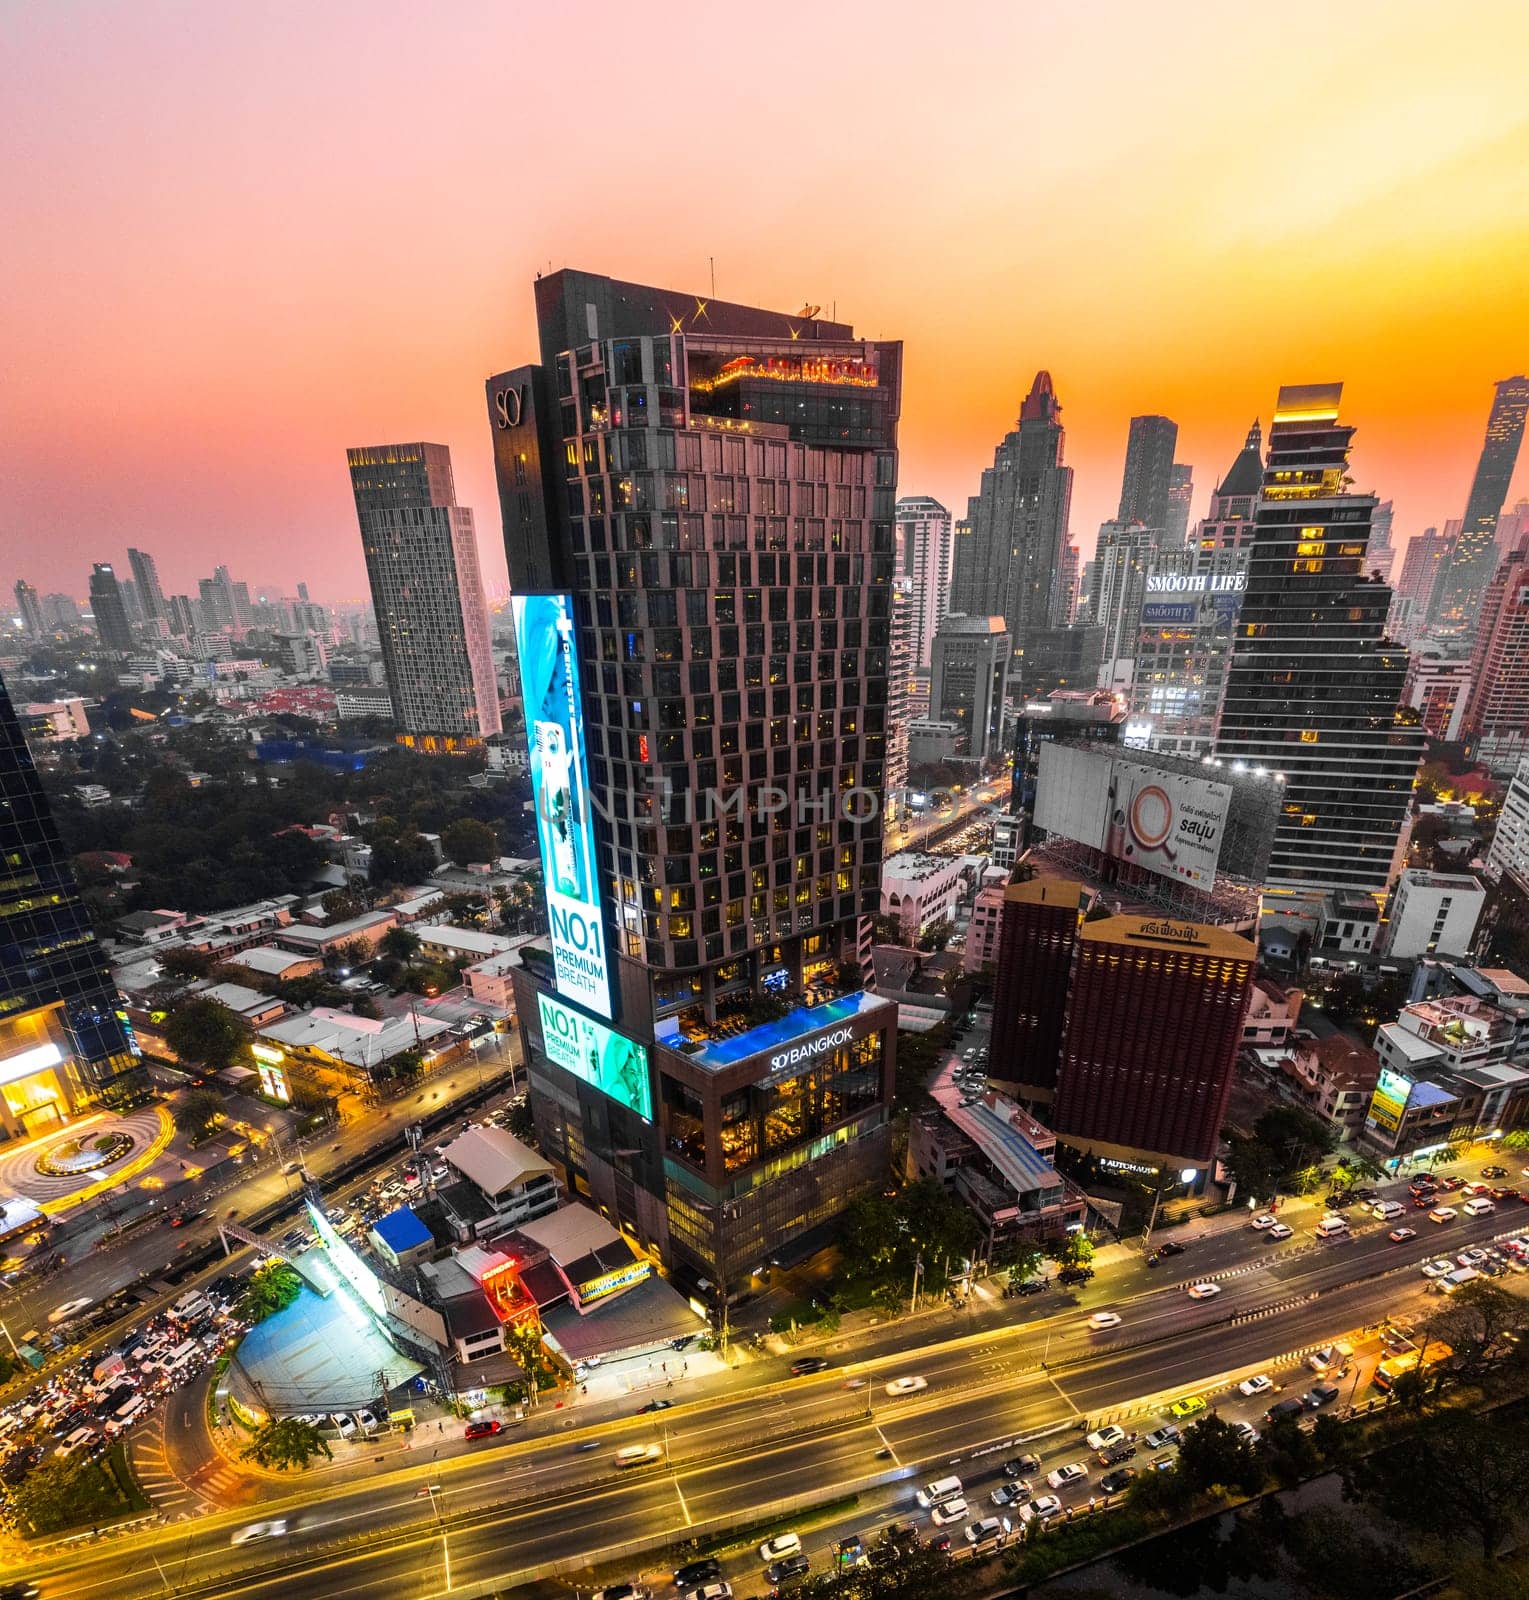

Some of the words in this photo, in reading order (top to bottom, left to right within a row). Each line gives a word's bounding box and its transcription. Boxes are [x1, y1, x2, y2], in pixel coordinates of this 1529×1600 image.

[1180, 818, 1216, 843] รสนุ่ม
[551, 903, 601, 958] NO.1
[555, 946, 604, 980] PREMIUM
[557, 963, 596, 994] BREATH
[541, 1001, 579, 1043] NO.1
[545, 1030, 580, 1058] PREMIUM
[790, 1026, 853, 1064] BANGKOK
